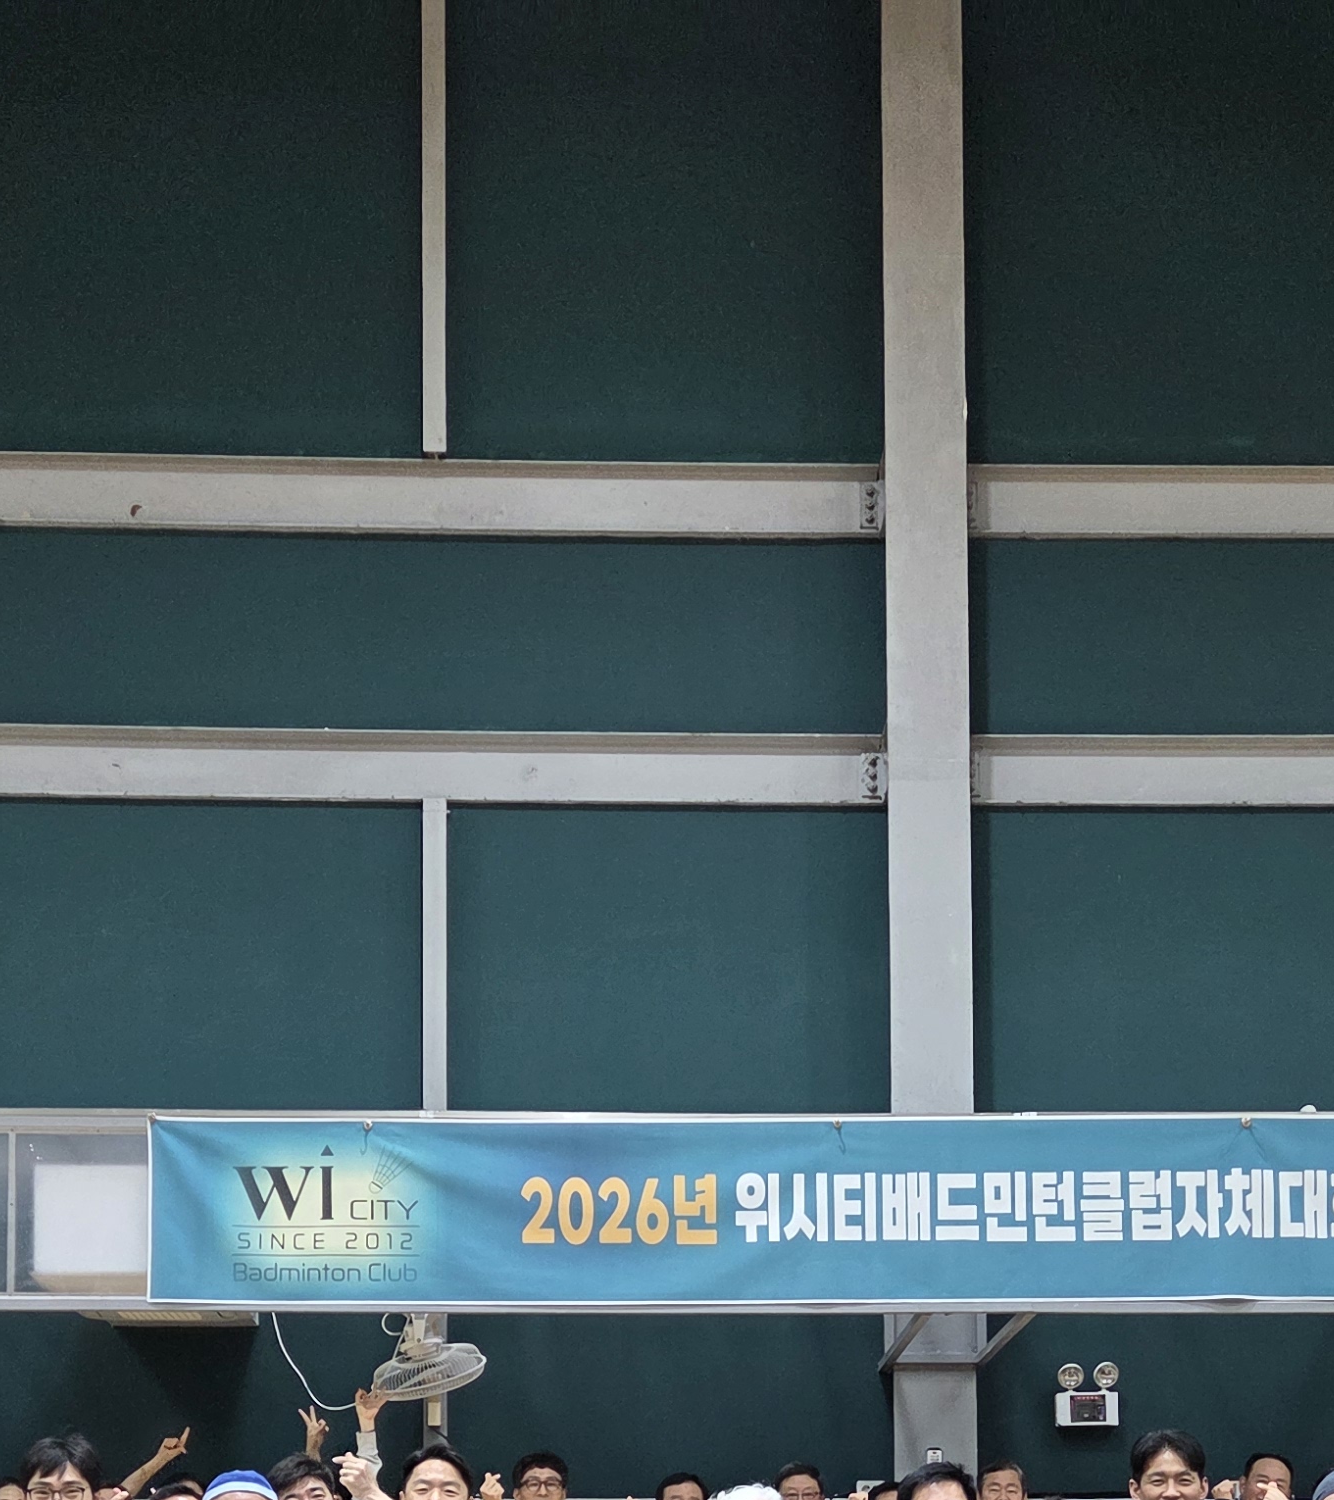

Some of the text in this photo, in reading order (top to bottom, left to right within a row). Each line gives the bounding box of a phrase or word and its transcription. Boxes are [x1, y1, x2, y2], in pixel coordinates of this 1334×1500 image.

[350, 1199, 419, 1221] CITY
[520, 1173, 718, 1245] 2026년
[237, 1232, 413, 1250] SINCE 2012
[233, 1262, 417, 1282] Badminton Club
